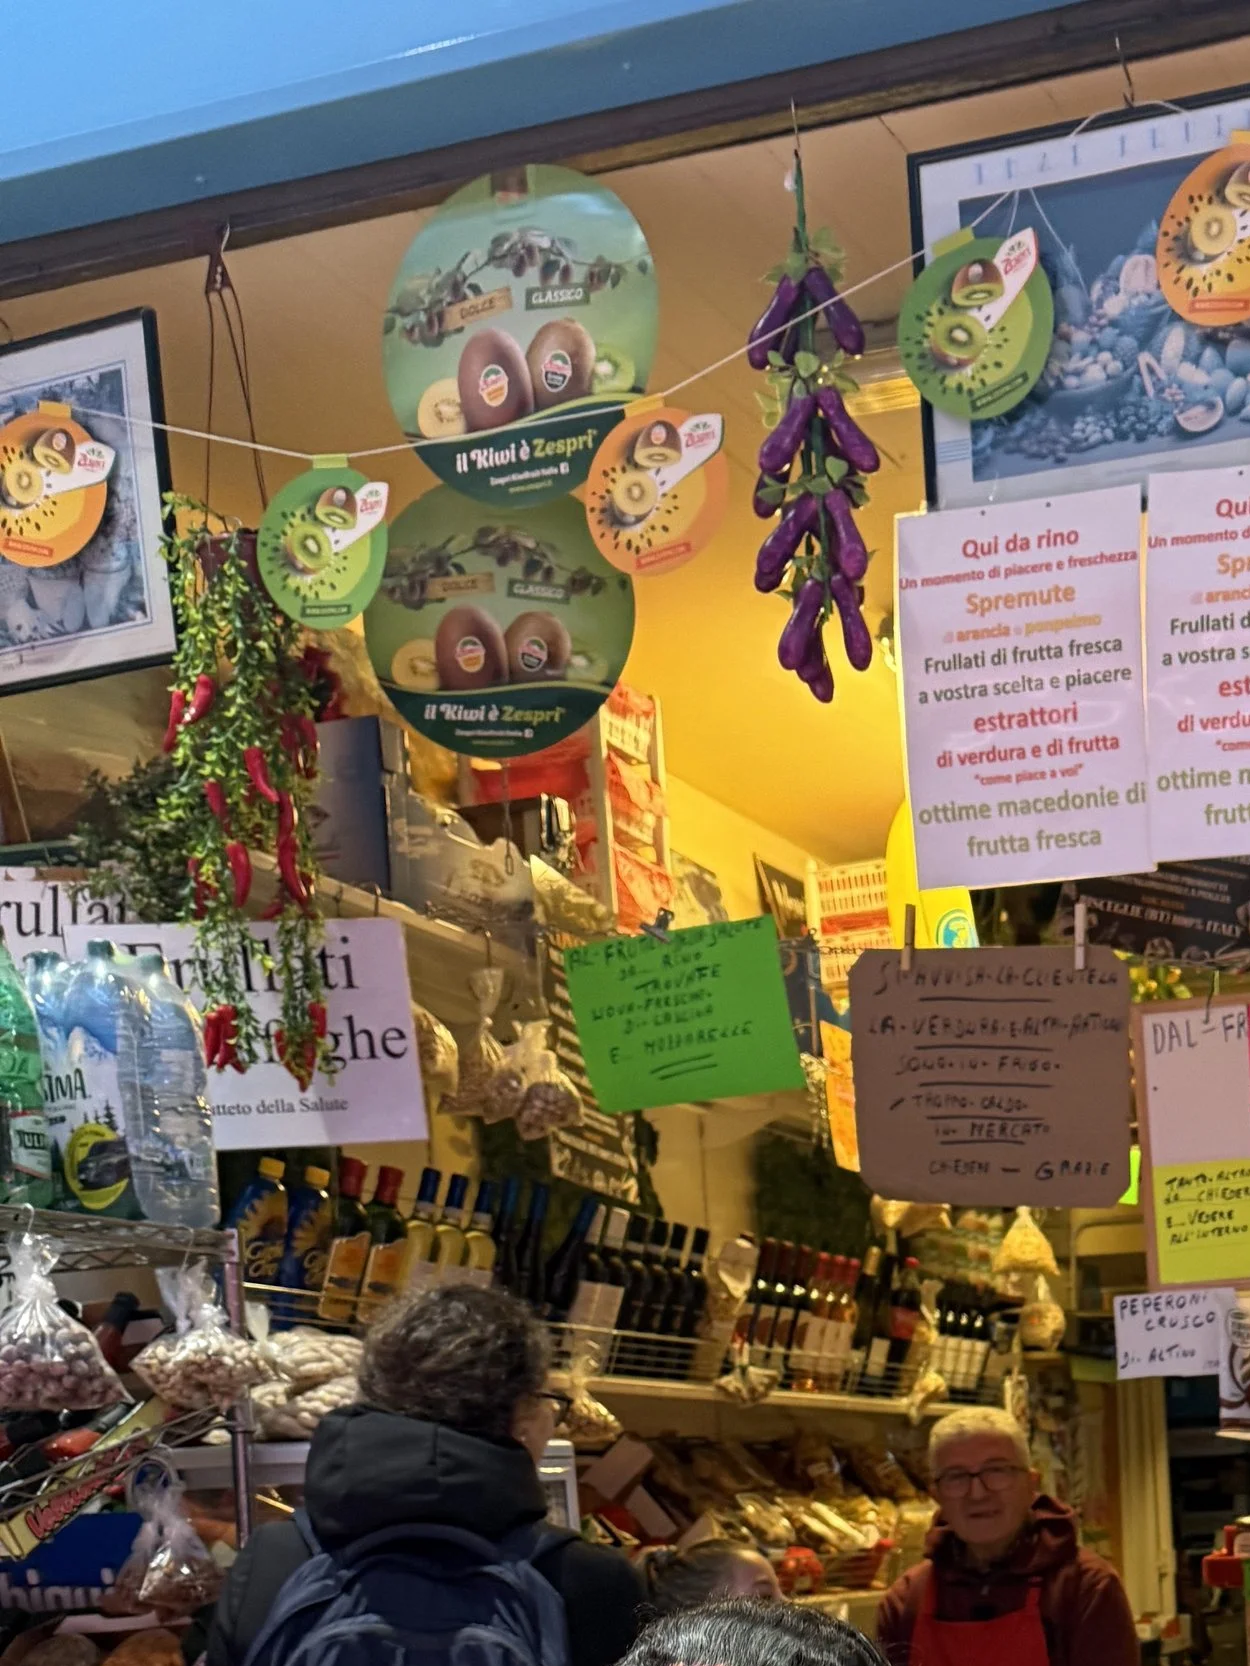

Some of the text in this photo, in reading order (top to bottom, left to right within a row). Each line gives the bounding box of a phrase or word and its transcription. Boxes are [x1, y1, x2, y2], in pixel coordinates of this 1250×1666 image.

[460, 288, 583, 319] DOLCE CLASSICO
[455, 452, 468, 474] il
[470, 444, 517, 471] Kiwi
[519, 438, 530, 460] è
[962, 528, 1079, 560] Qui da rino
[1147, 536, 1168, 549] Un
[1171, 528, 1238, 546] momento
[899, 549, 1137, 590] Un momento di piacere e freschezza
[965, 584, 1076, 617] Spremute
[1170, 612, 1235, 636] Frullati
[924, 637, 1123, 675] Frullati di frutta fresca
[1161, 652, 1173, 666] a
[1177, 646, 1236, 665] vostra
[918, 665, 1132, 705] a vostra scelta e piacere
[424, 704, 437, 721] il
[439, 703, 485, 722] Kiwi
[973, 701, 1078, 734] estrattori
[1177, 714, 1195, 733] di
[936, 733, 1120, 769] di verdura e di frutta
[1156, 767, 1232, 792] ottime
[918, 781, 1147, 826] ottime macedonie di
[967, 828, 1102, 858] frutta fresca
[256, 1099, 295, 1115] della
[300, 1097, 350, 1115] Salute
